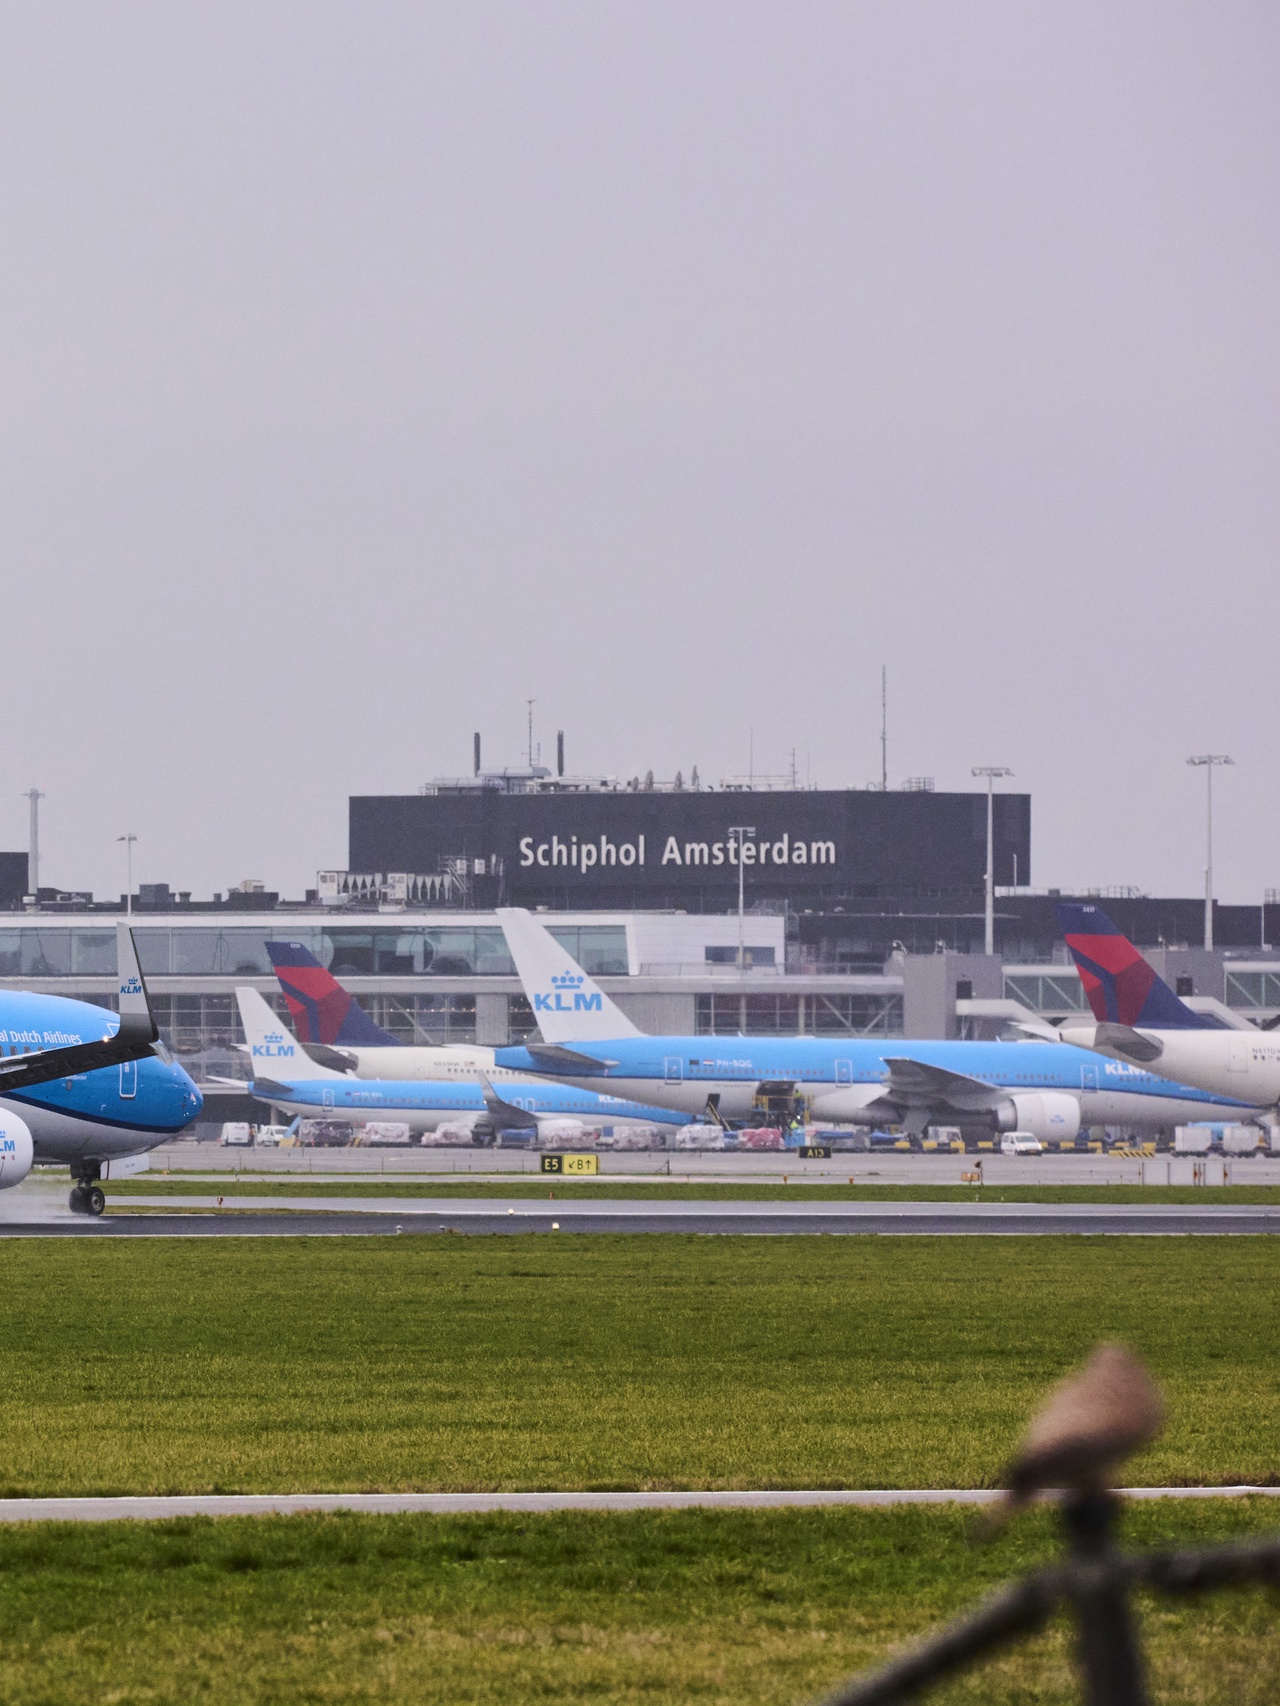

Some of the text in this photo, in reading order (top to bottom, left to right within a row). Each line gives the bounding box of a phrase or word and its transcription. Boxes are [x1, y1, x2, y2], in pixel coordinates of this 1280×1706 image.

[519, 833, 836, 874] Schiphol Amsterdam
[120, 985, 142, 994] KLM
[534, 993, 603, 1011] KLM
[9, 1030, 42, 1043] Dutch
[43, 1030, 83, 1045] Airlines
[252, 1045, 295, 1057] KLM
[807, 1148, 825, 1158] A13
[545, 1158, 584, 1170] E5 B
